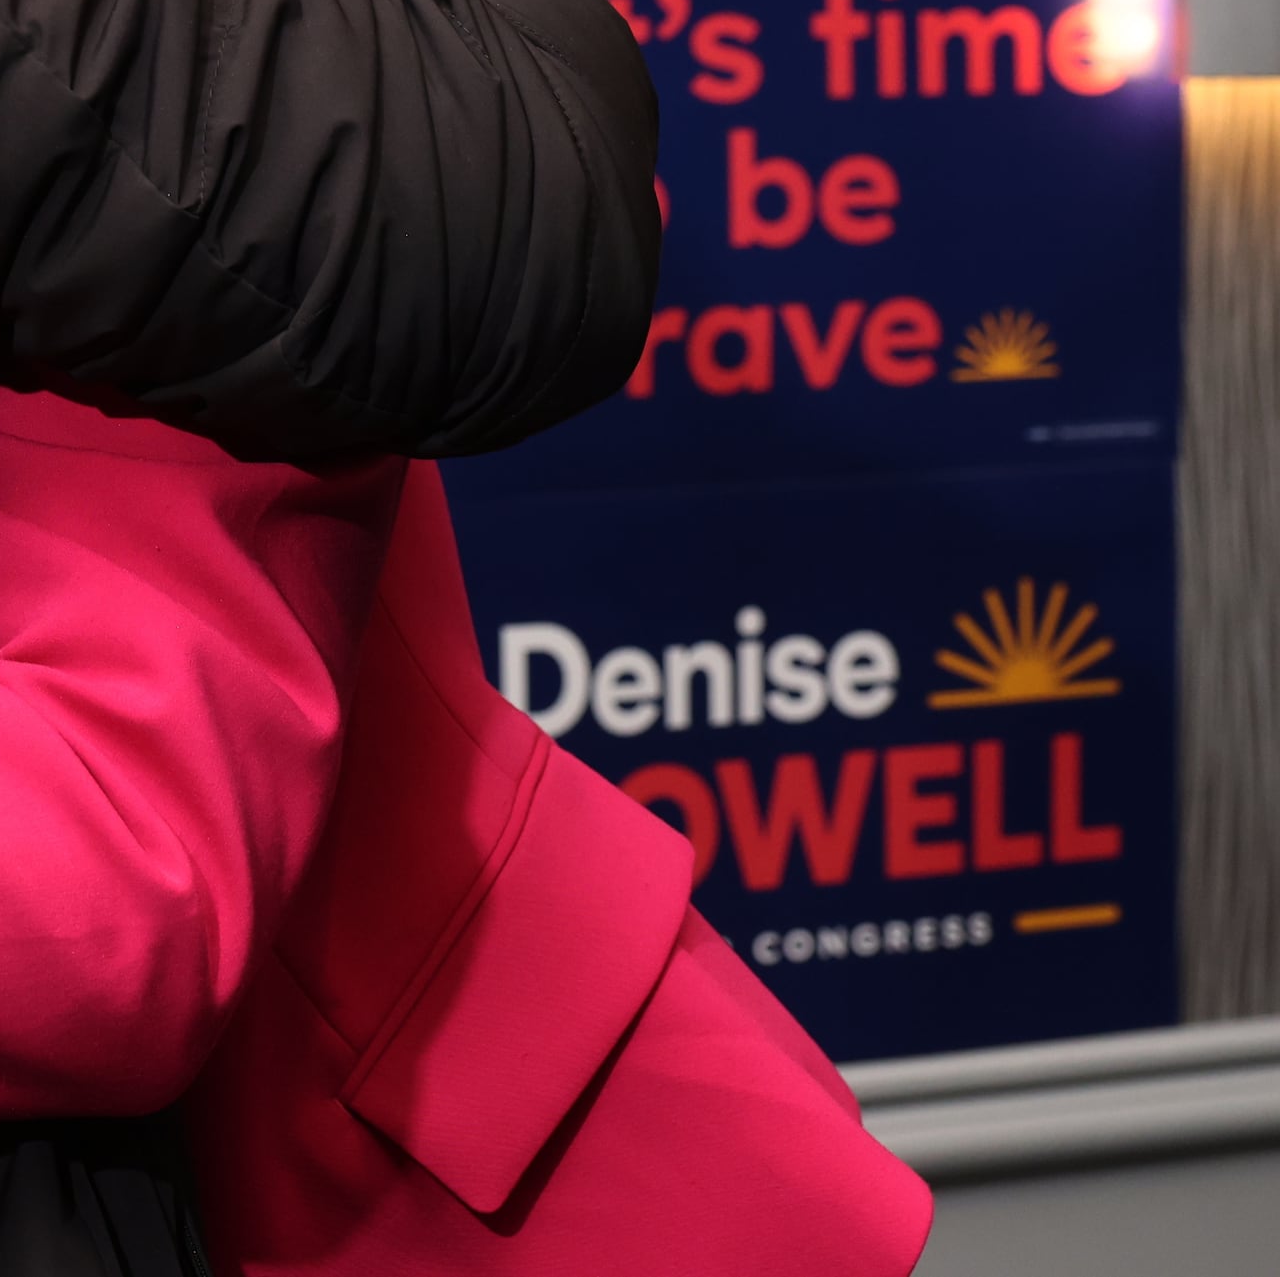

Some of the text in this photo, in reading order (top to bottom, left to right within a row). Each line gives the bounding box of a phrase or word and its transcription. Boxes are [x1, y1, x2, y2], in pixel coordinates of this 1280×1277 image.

[728, 128, 900, 248] be
[625, 296, 942, 398] rave
[499, 606, 900, 738] Denise
[751, 912, 992, 966] CONGRESS
